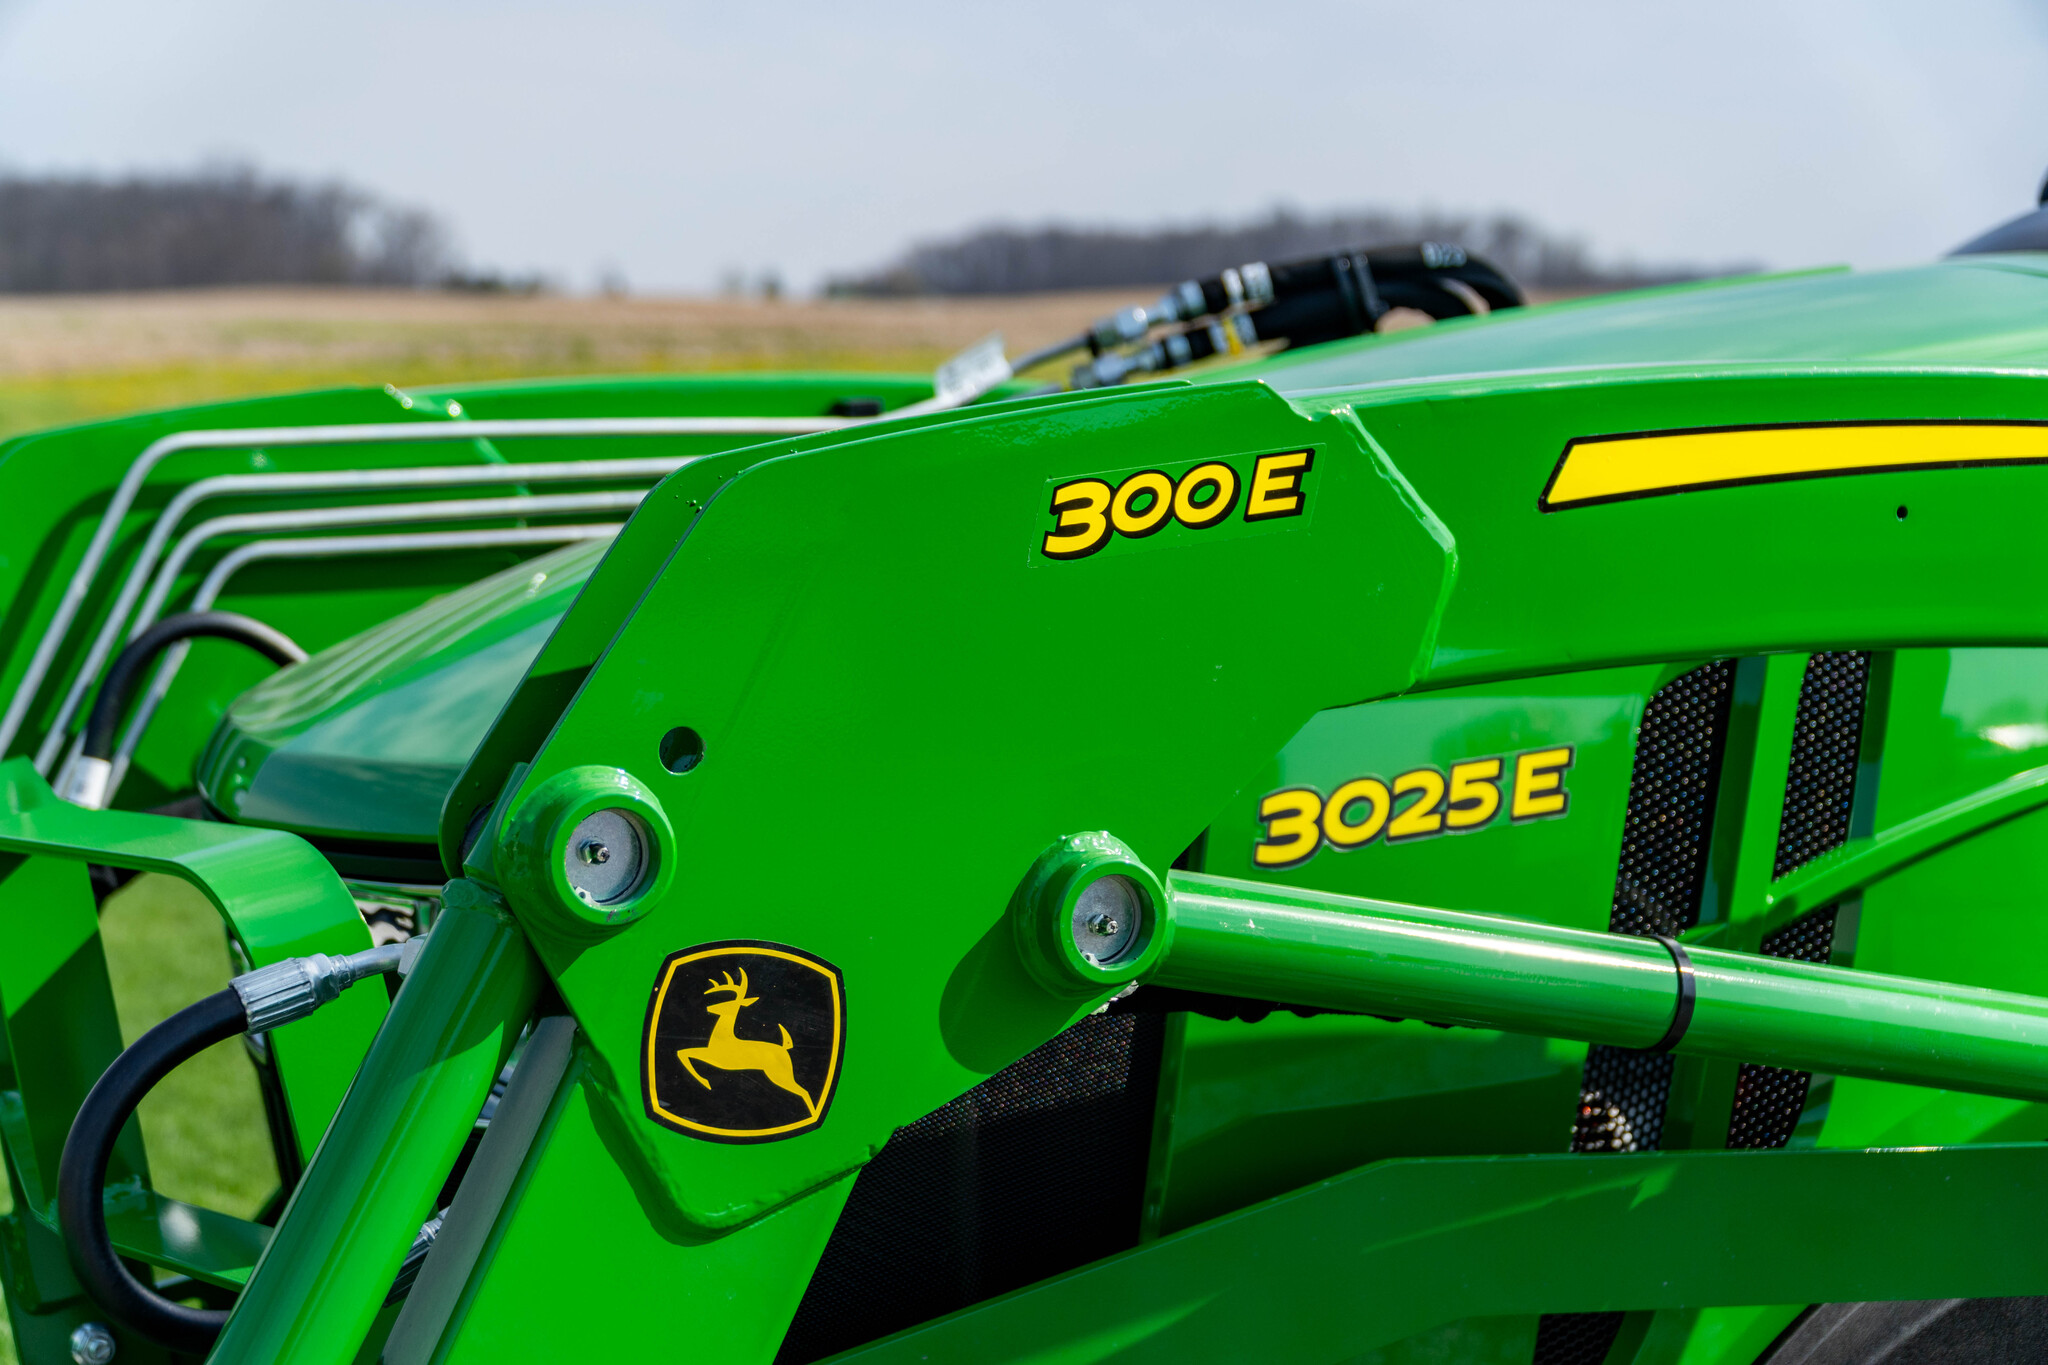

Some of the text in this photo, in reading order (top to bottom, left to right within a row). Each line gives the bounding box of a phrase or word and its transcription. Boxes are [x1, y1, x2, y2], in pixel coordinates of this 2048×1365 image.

[1042, 448, 1315, 560] 300 E
[1253, 746, 1574, 867] 3025 E
